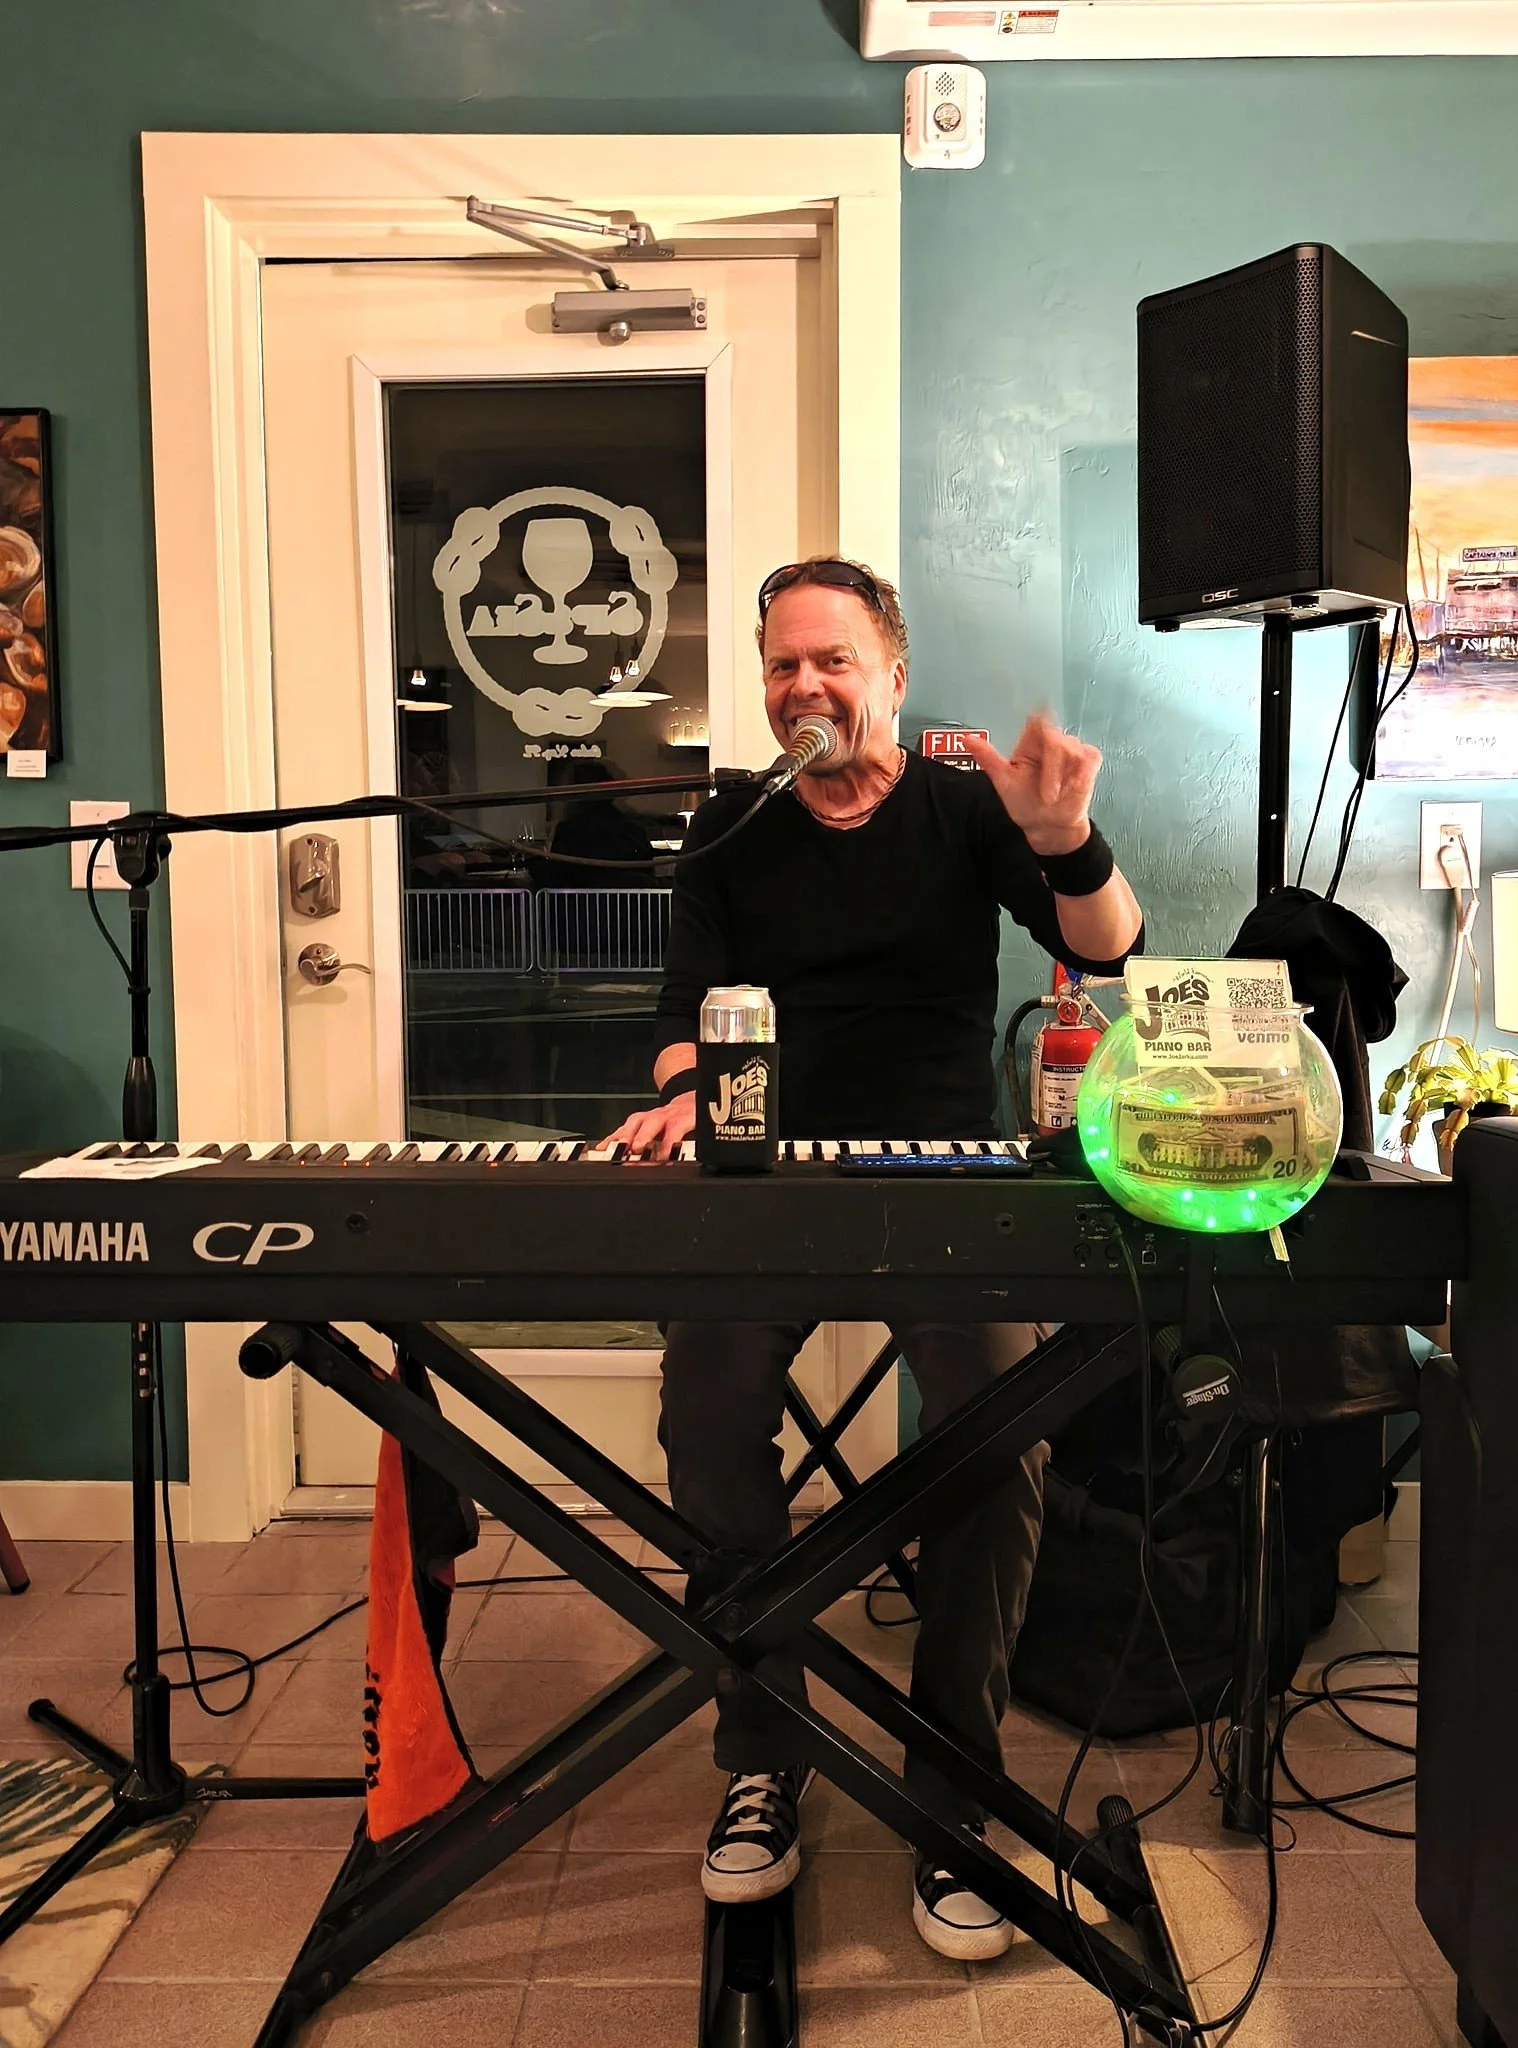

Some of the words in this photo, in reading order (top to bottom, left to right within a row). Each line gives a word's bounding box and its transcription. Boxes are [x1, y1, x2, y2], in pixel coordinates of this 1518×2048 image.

[1201, 588, 1240, 603] QSC
[931, 733, 981, 752] FIR
[1134, 974, 1211, 1041] JOE'S
[1144, 1041, 1183, 1052] PIANO
[1187, 1041, 1212, 1052] BAR
[1237, 1033, 1290, 1044] venmo
[708, 1063, 768, 1125] JOE'S
[715, 1125, 745, 1135] PIANO
[748, 1125, 766, 1135] BAR
[1272, 1159, 1297, 1179] 20
[0, 1220, 150, 1262] YAMAHA
[191, 1221, 315, 1265] CP
